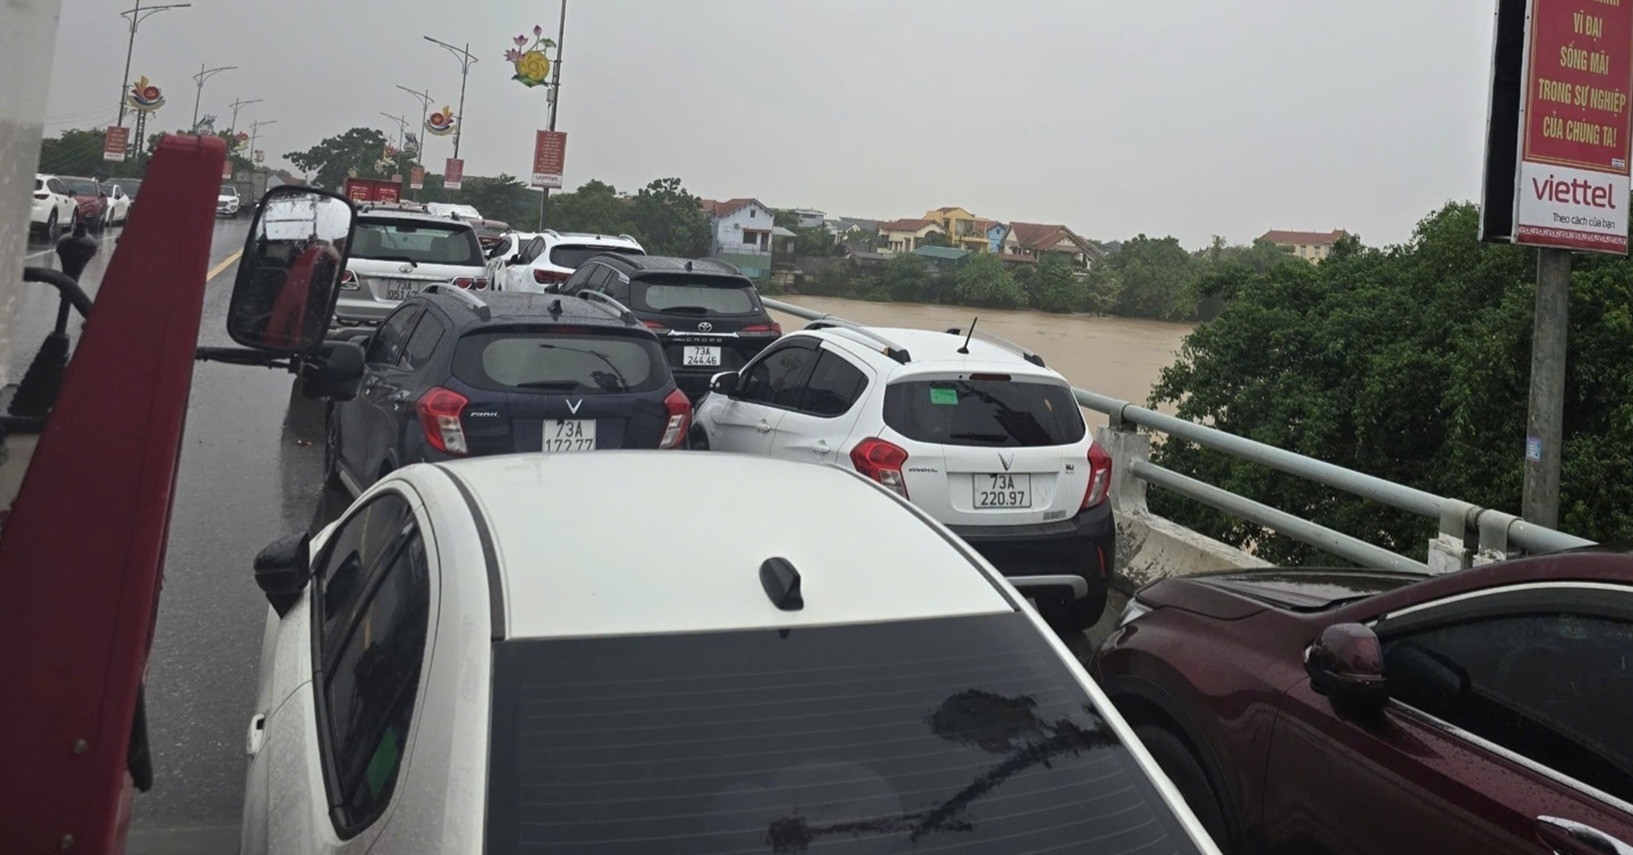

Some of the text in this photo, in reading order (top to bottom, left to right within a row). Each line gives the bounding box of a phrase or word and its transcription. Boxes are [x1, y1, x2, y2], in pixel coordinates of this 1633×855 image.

[1574, 9, 1602, 42] VĨ ĐẠI
[1560, 41, 1609, 75] SỐNG MÃI
[1538, 78, 1626, 117] TRONG SỰ NGHIỆP
[1543, 110, 1617, 148] CỦA CHÚNG TA!
[1532, 174, 1616, 209] viettel
[1553, 212, 1615, 229] Theo cách của bạn
[694, 346, 711, 356] 73A
[687, 356, 718, 366] 244.46
[556, 420, 583, 438] 73A
[990, 473, 1014, 490] 73A
[980, 491, 1025, 506] 220.97
